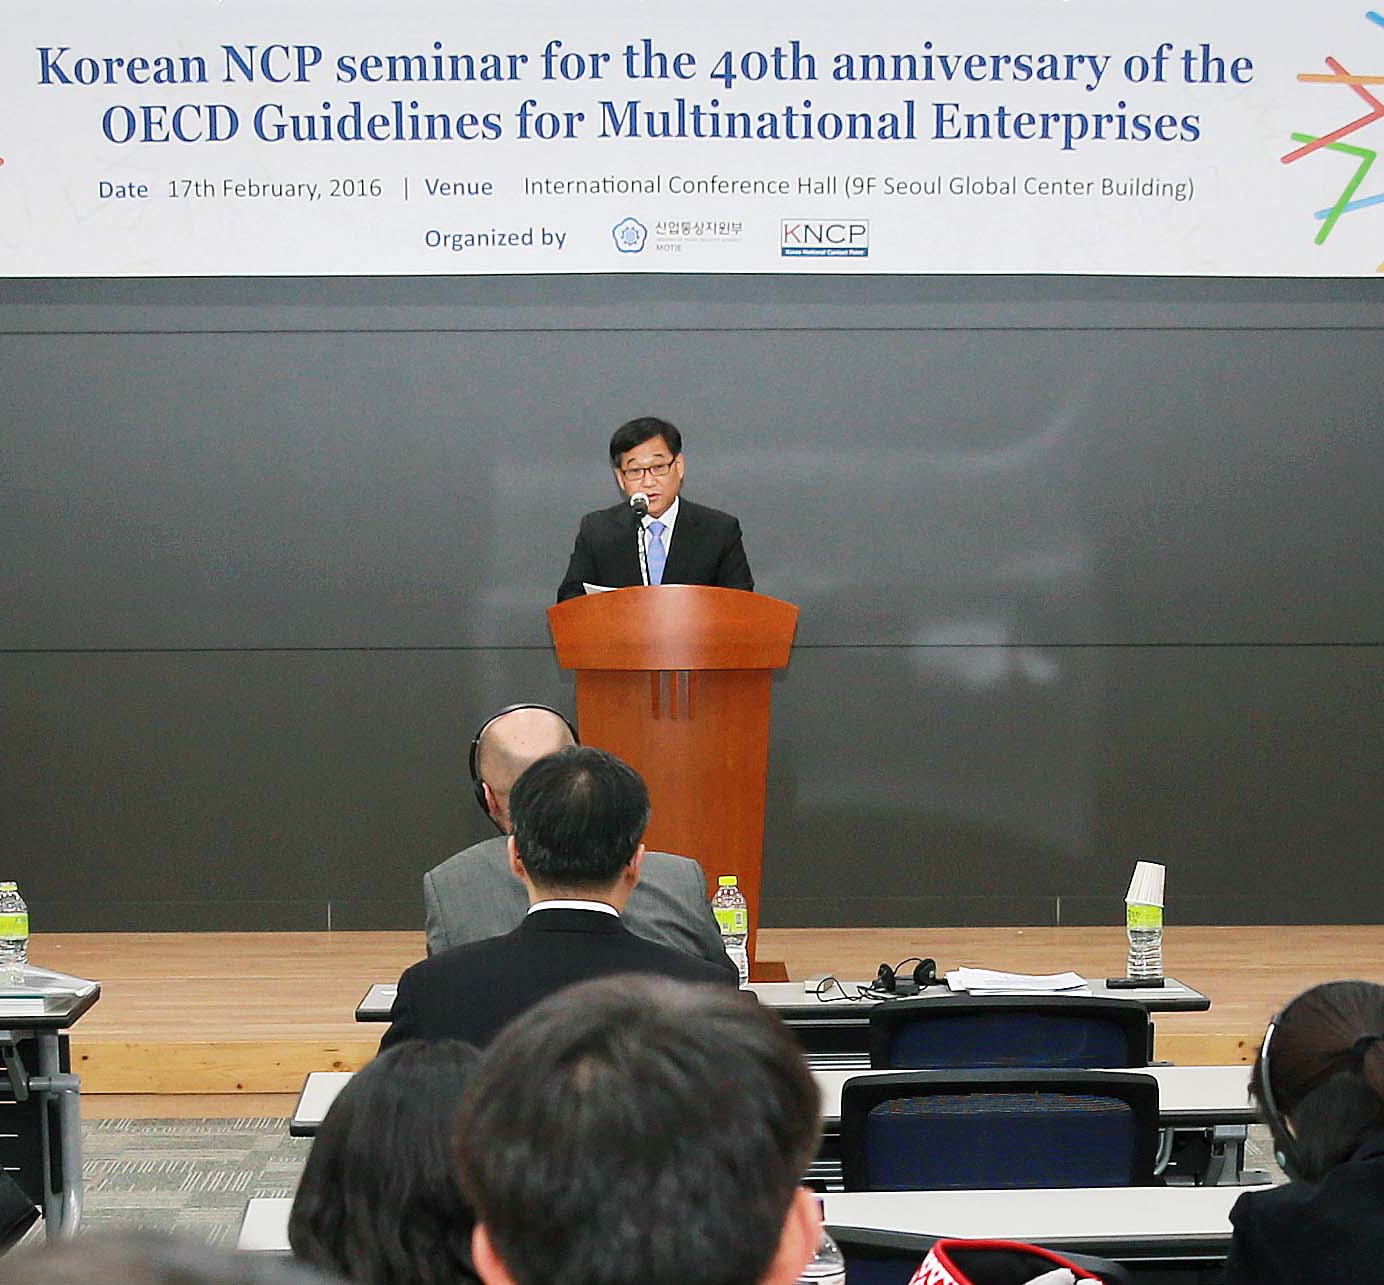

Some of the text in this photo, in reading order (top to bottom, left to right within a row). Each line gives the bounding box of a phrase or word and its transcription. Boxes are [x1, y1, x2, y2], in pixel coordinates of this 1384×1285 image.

[36, 38, 1253, 92] Korean NCP seminar for the 40th anniversary of the
[103, 98, 1200, 150] OECD Guidelines for Multinational Enterprises
[99, 175, 1193, 201] Date 17th February, 2016 Venue International Conference Hall (9F Seoul Global Center Building)
[426, 227, 566, 251] Organized by
[785, 224, 866, 243] KNCP
